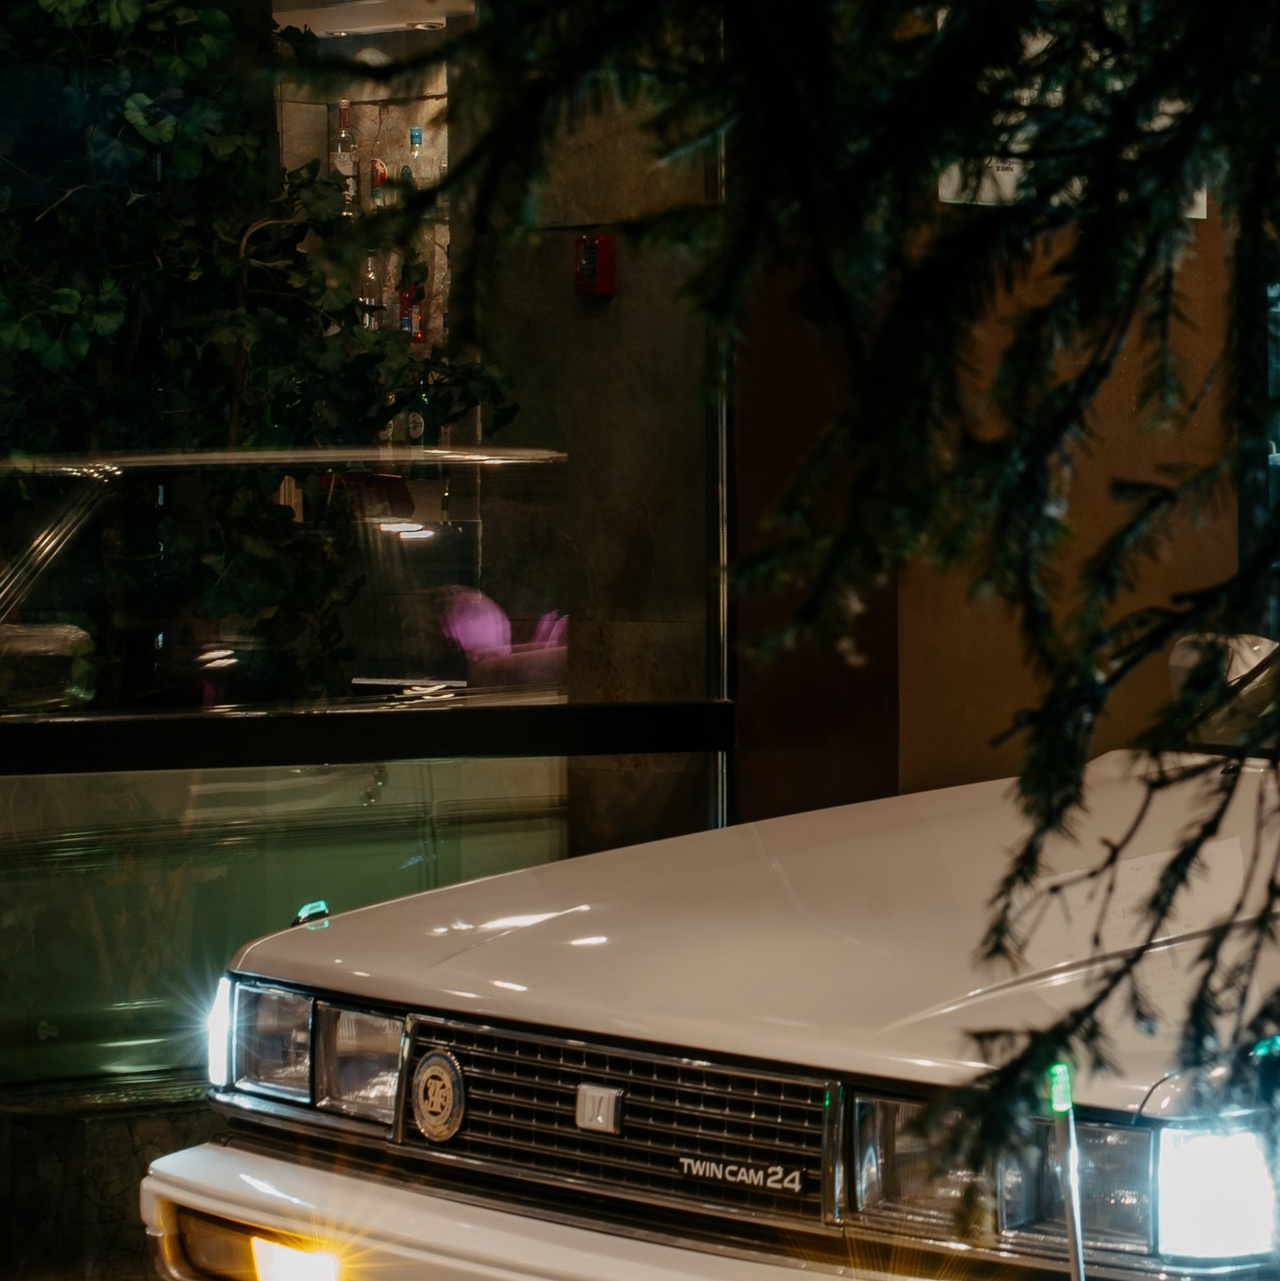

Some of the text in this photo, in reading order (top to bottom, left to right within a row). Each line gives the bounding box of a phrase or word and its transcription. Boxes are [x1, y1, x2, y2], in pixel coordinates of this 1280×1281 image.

[679, 1157, 801, 1193] TWIN CAM 24
